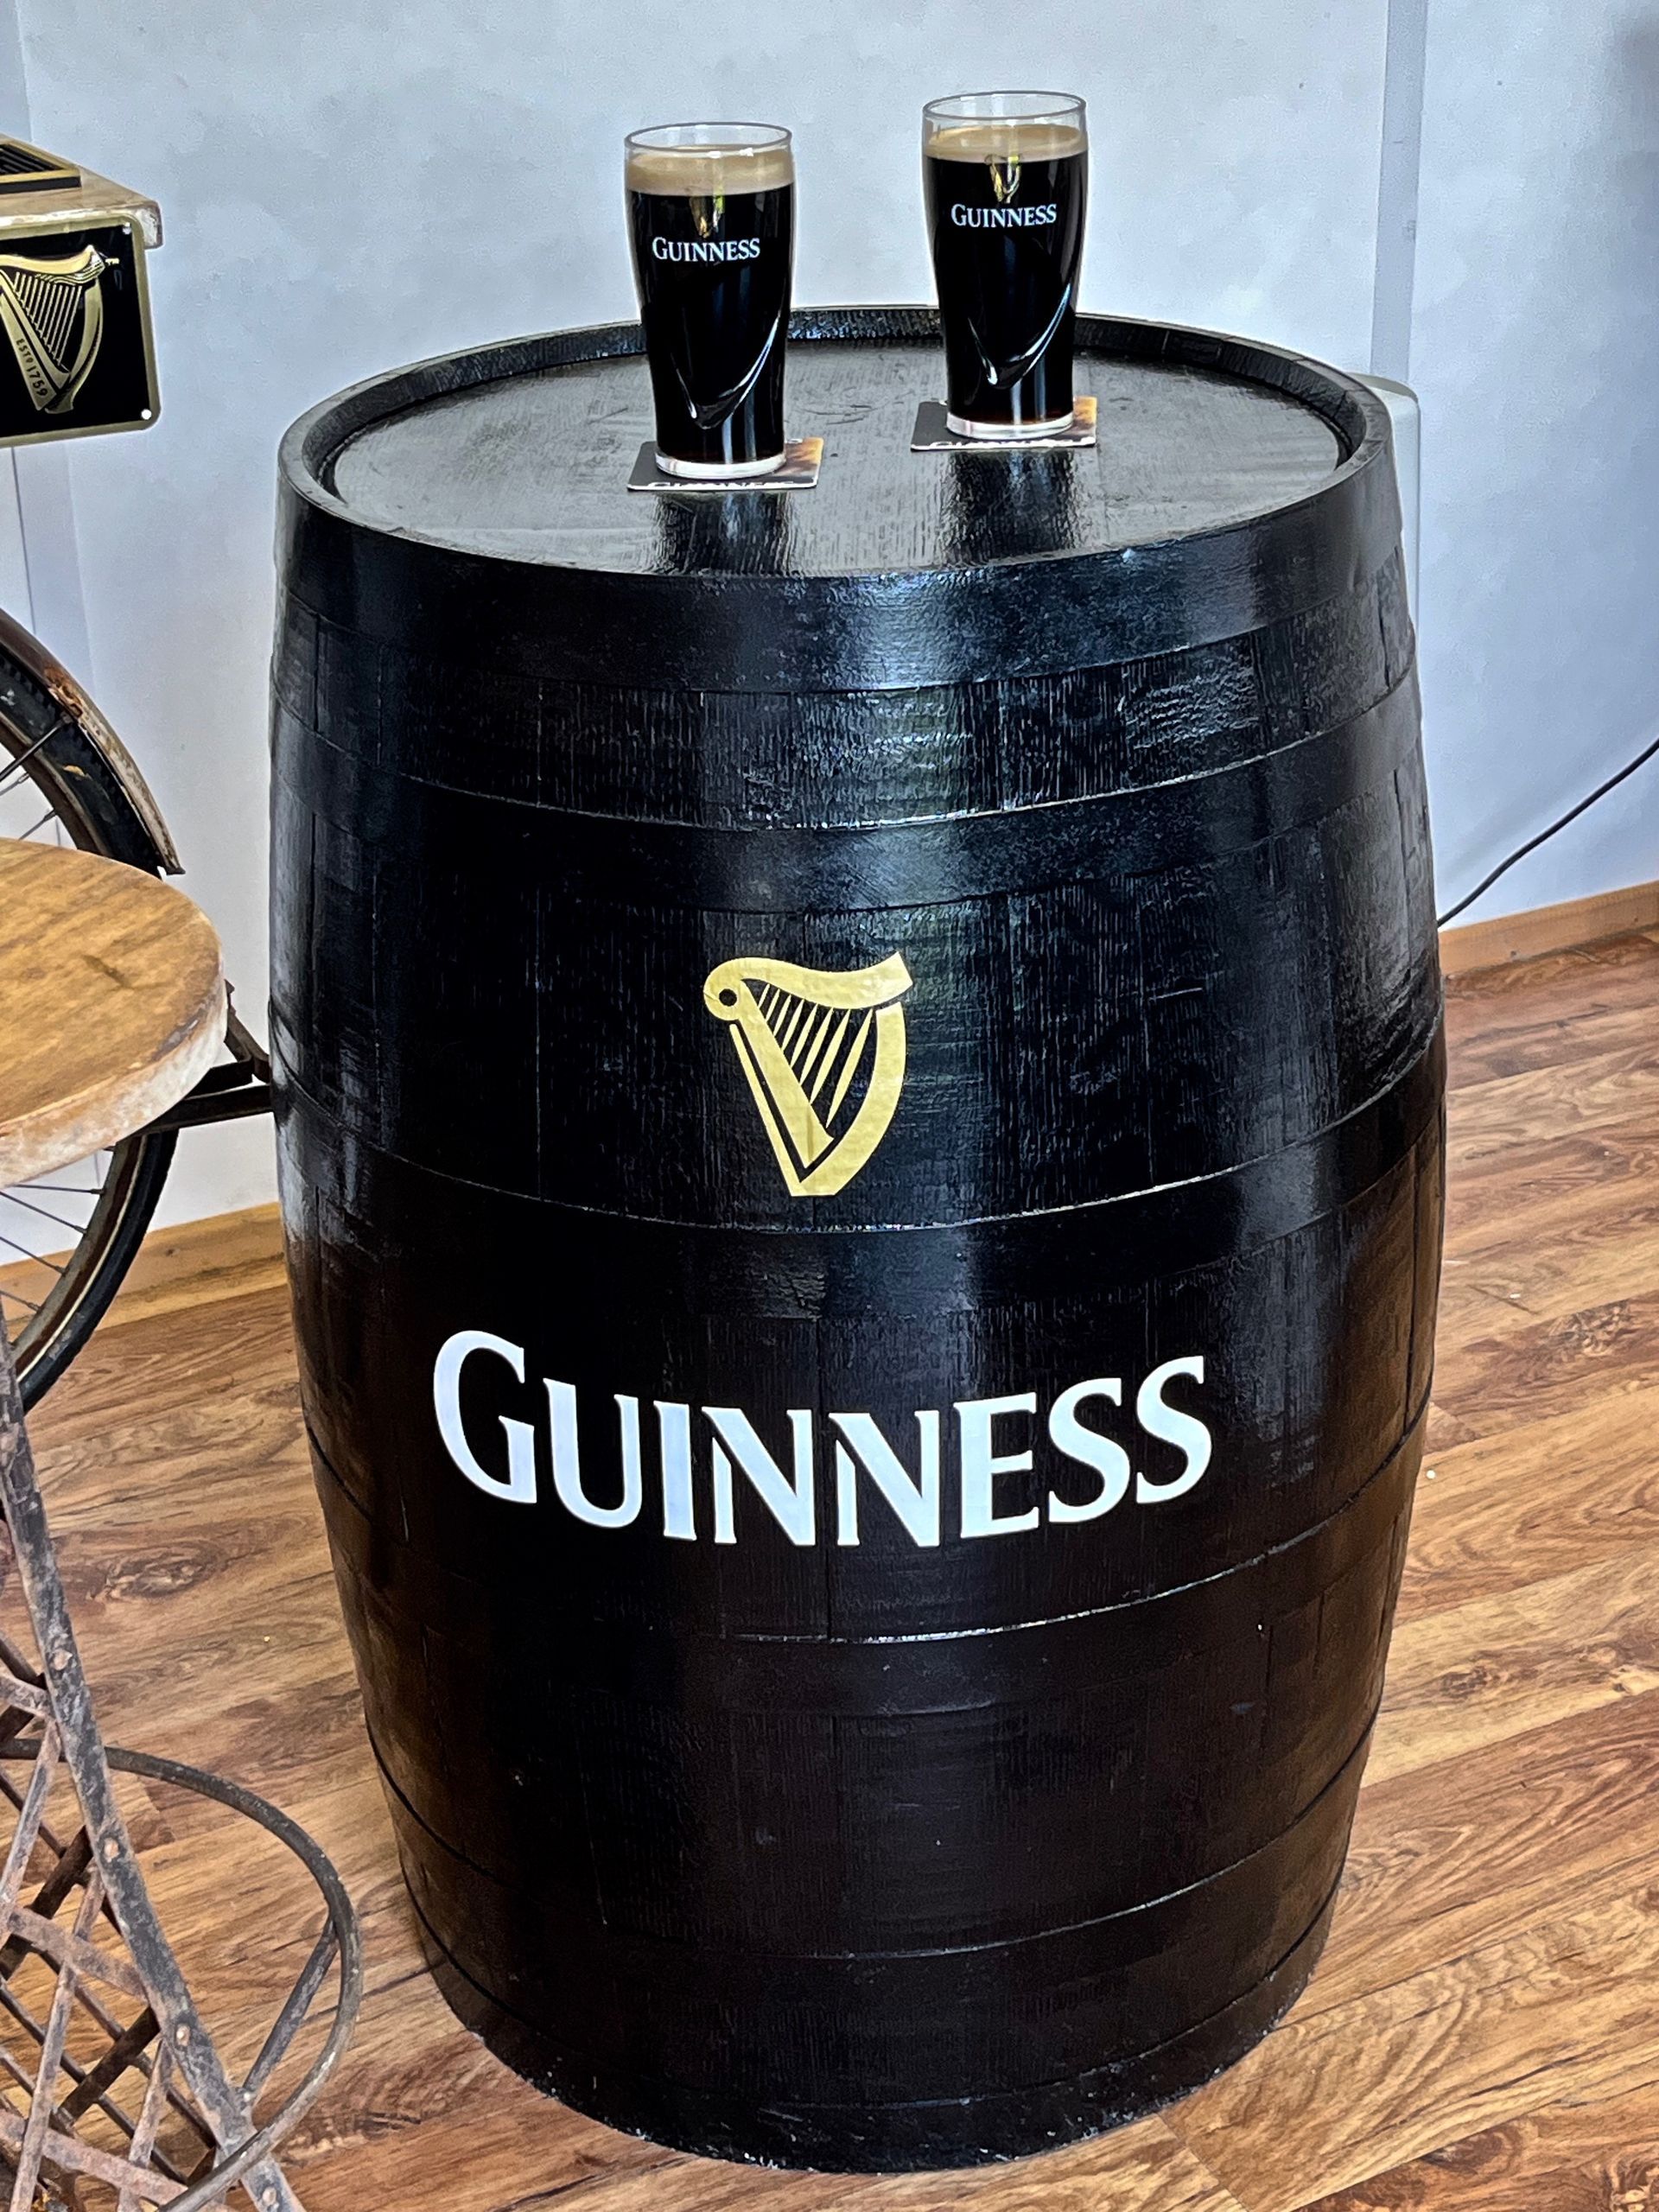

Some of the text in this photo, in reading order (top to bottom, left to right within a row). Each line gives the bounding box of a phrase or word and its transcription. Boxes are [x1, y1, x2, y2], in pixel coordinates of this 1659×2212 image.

[950, 203, 1057, 228] GUINNESS
[652, 236, 760, 262] GUINNESS
[27, 365, 48, 396] 1759
[434, 1330, 1212, 1547] GUINNESS
